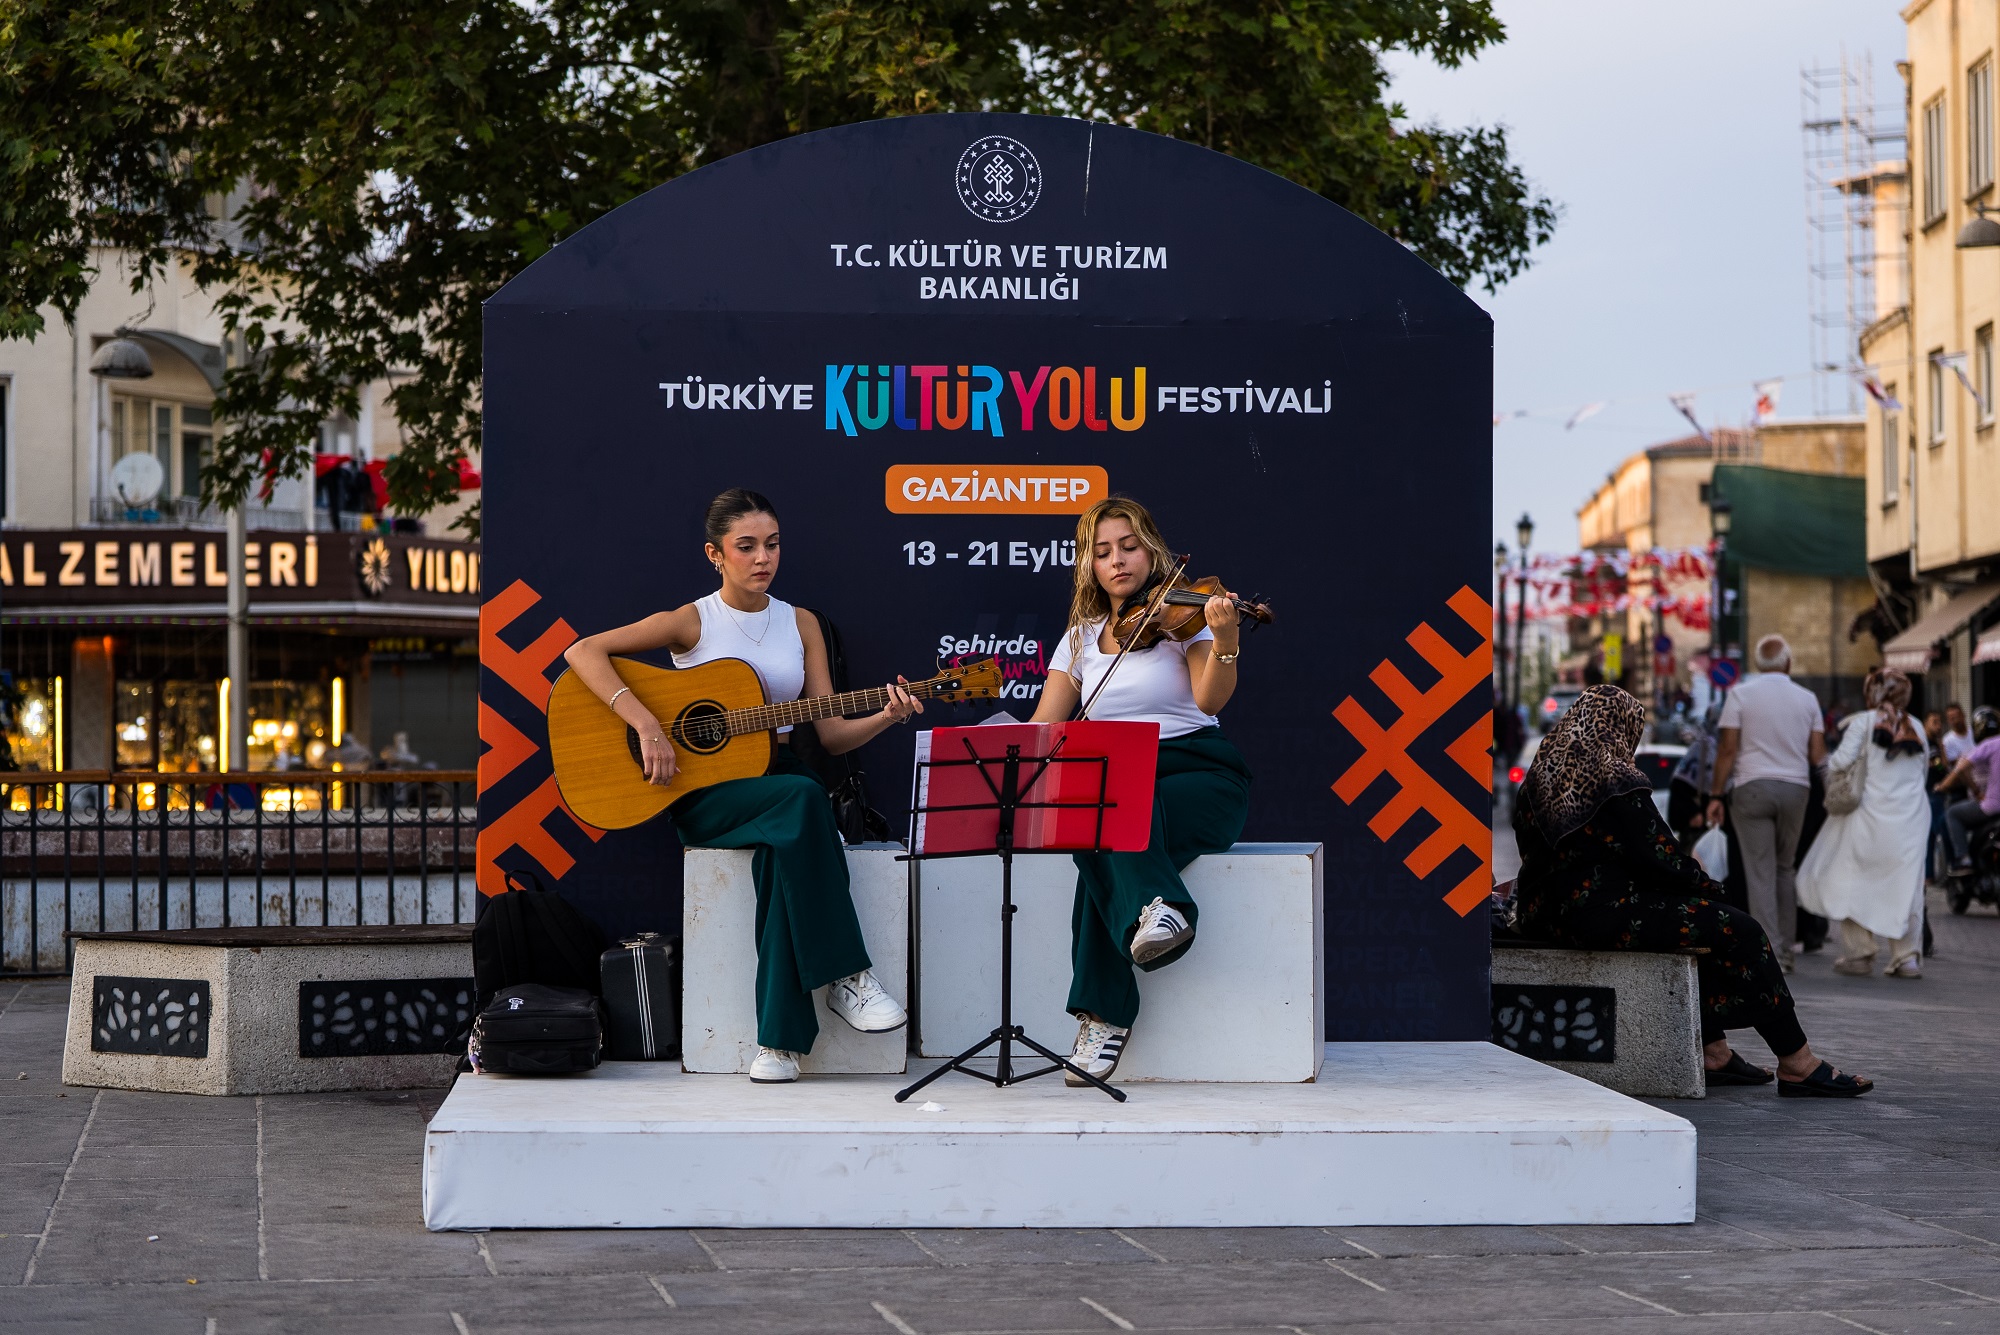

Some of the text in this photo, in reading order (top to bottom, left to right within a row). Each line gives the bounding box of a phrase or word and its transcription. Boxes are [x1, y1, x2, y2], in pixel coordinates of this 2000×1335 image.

[831, 239, 1167, 269] T.C. KÜLTÜR VE TURİZM
[920, 271, 1079, 301] BAKANLIĞI
[659, 365, 1331, 437] TÜRKİYE KÜLTÜR YOLU FESTİVALİ
[903, 470, 1089, 501] GAZİANTEP
[903, 541, 935, 565] 13
[968, 541, 998, 565] 21
[407, 547, 480, 594] YILDI
[937, 633, 1038, 658] Şehirde
[999, 679, 1047, 699] Var
